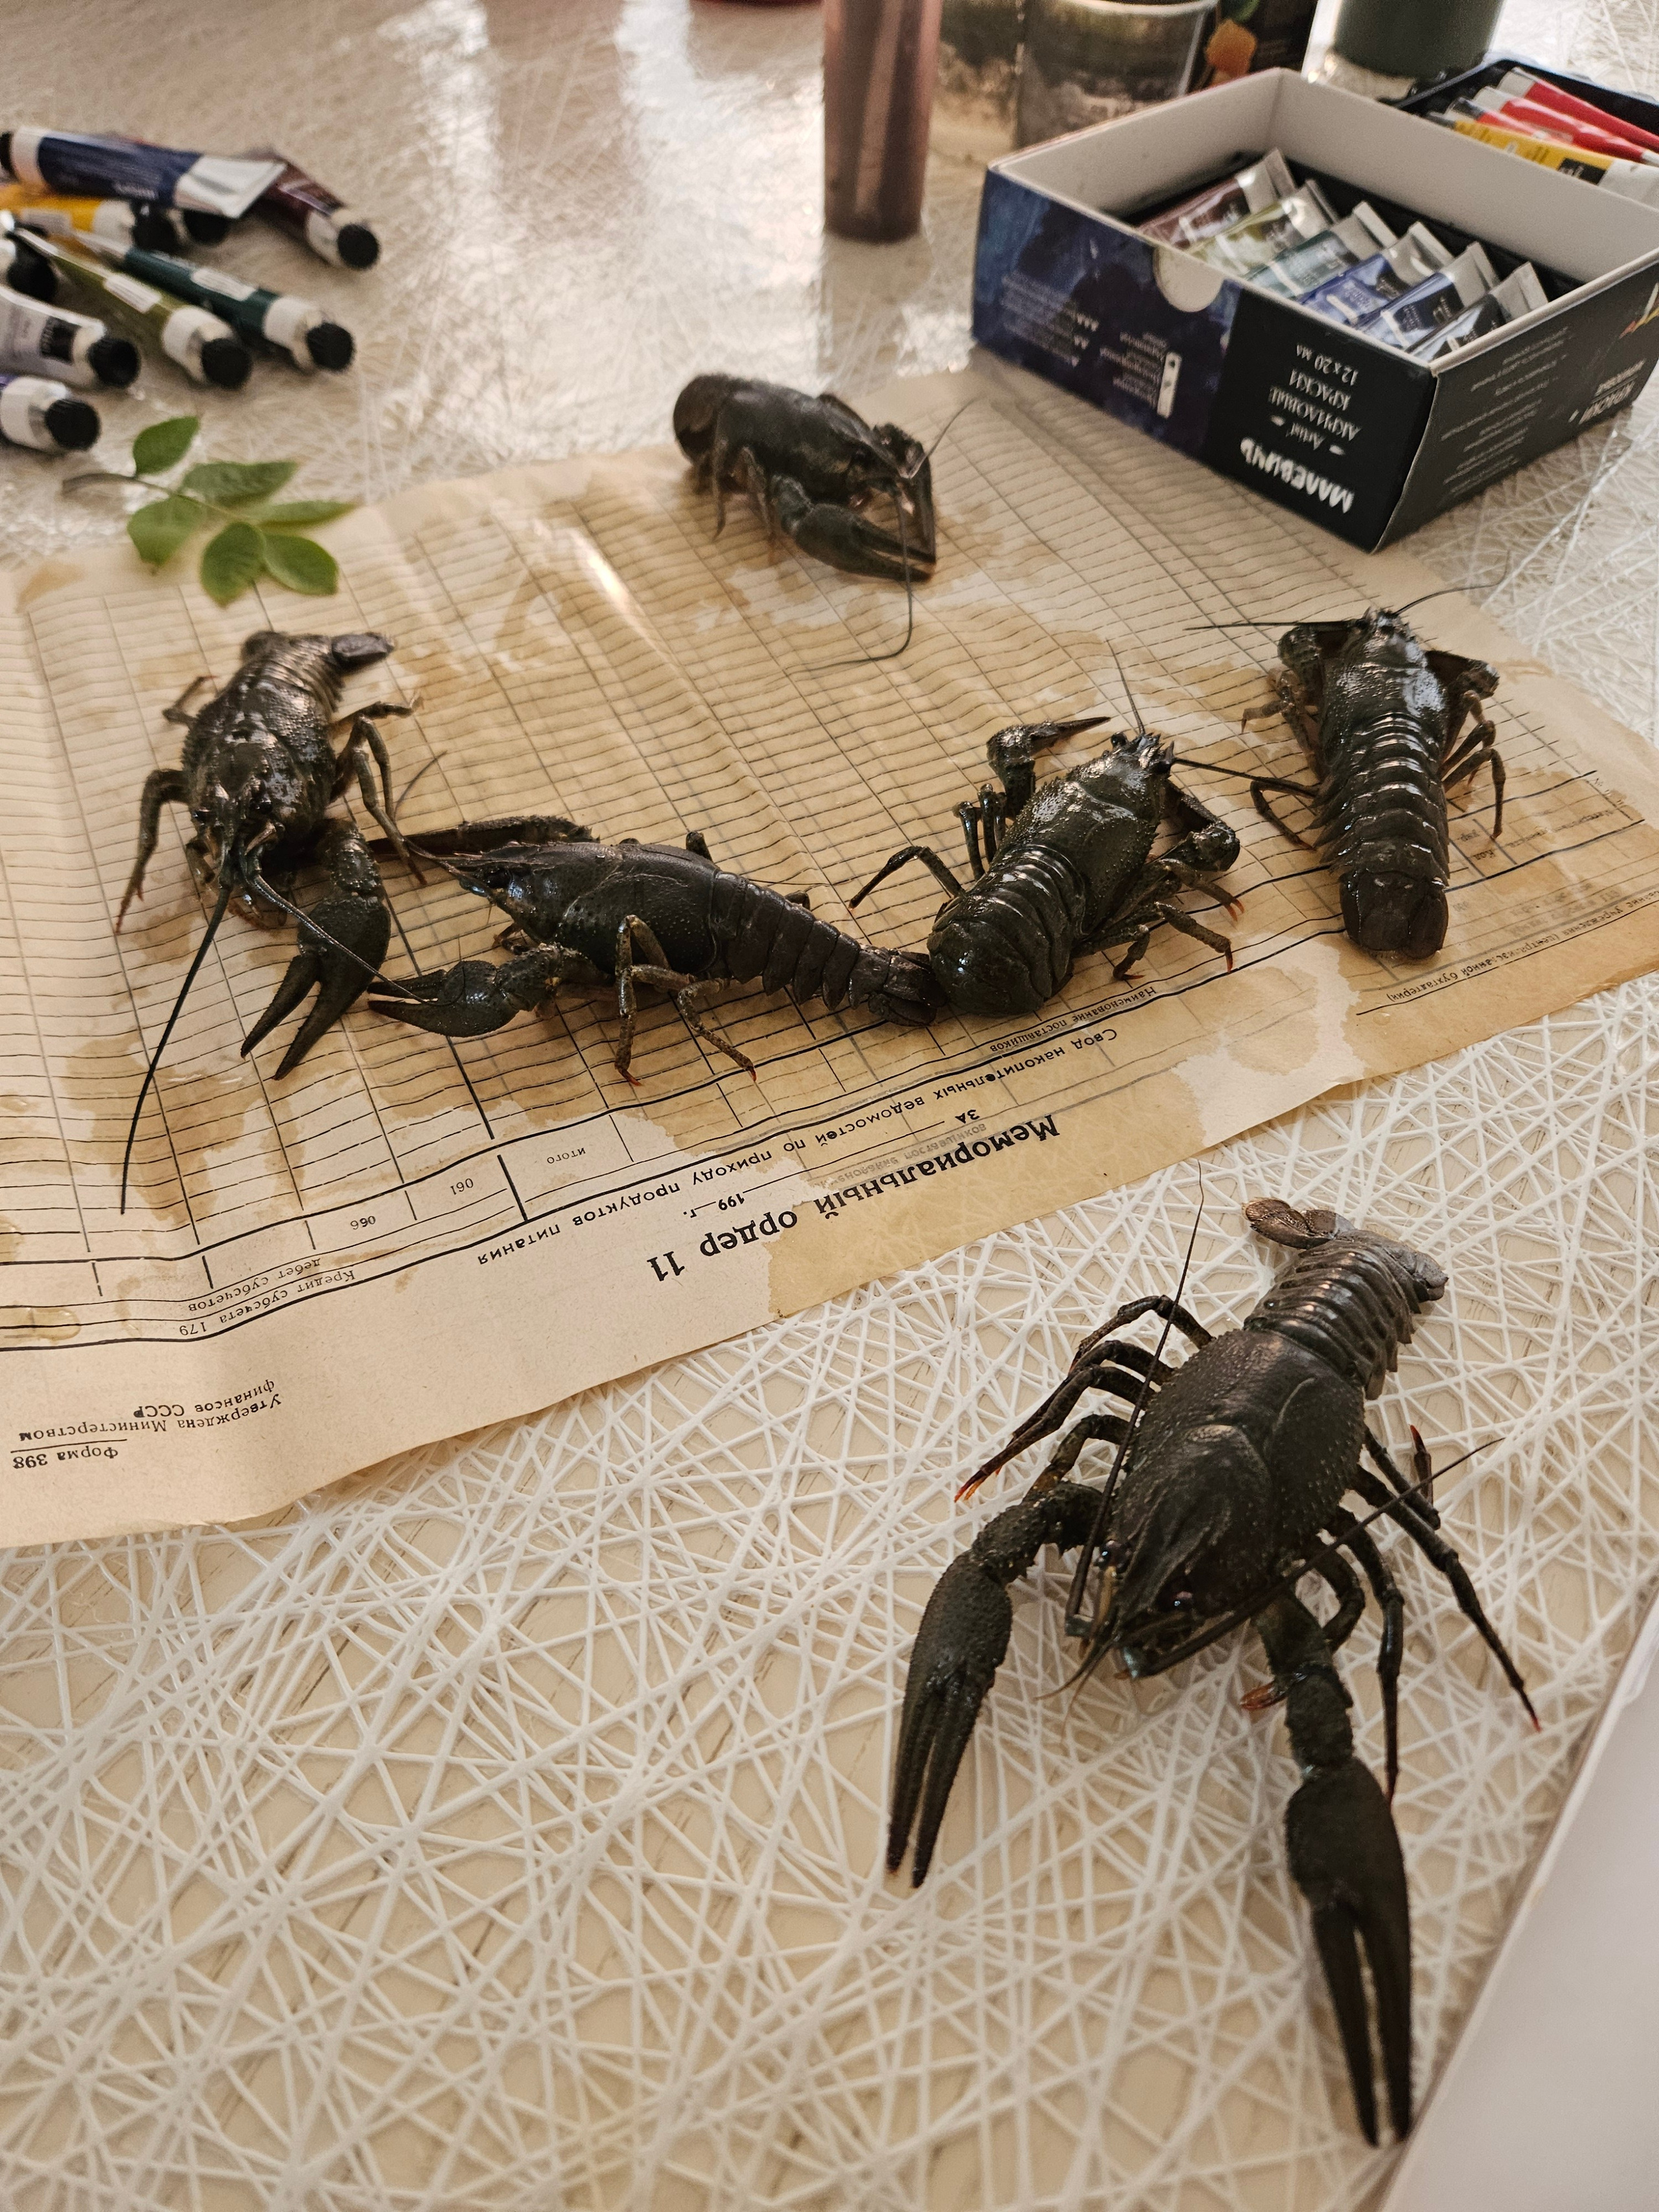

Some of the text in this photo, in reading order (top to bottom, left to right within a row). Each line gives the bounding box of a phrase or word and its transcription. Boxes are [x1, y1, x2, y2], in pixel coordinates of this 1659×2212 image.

[1268, 386, 1361, 441] АКРИЛОВЫЕ
[1289, 368, 1351, 411] КРАСКИ
[1240, 437, 1355, 513] МАЛЕВИЧЪ
[990, 986, 1157, 1053] Наименование поставщиков
[478, 1029, 1117, 1264] Свод накопительных ведомостей по приходу продуктов питания
[547, 1147, 586, 1164] итого
[450, 1178, 474, 1195] 061
[647, 1113, 1061, 1281] Мемориальный ордер 11
[350, 1215, 377, 1230] 066
[179, 1270, 356, 1336] Кредит субсчета 179
[188, 1258, 321, 1312] дебет субсчетов
[19, 1393, 282, 1443] Утверждена Министерством
[133, 1379, 275, 1418] финансов СССР
[12, 1447, 119, 1469] Форма 398
